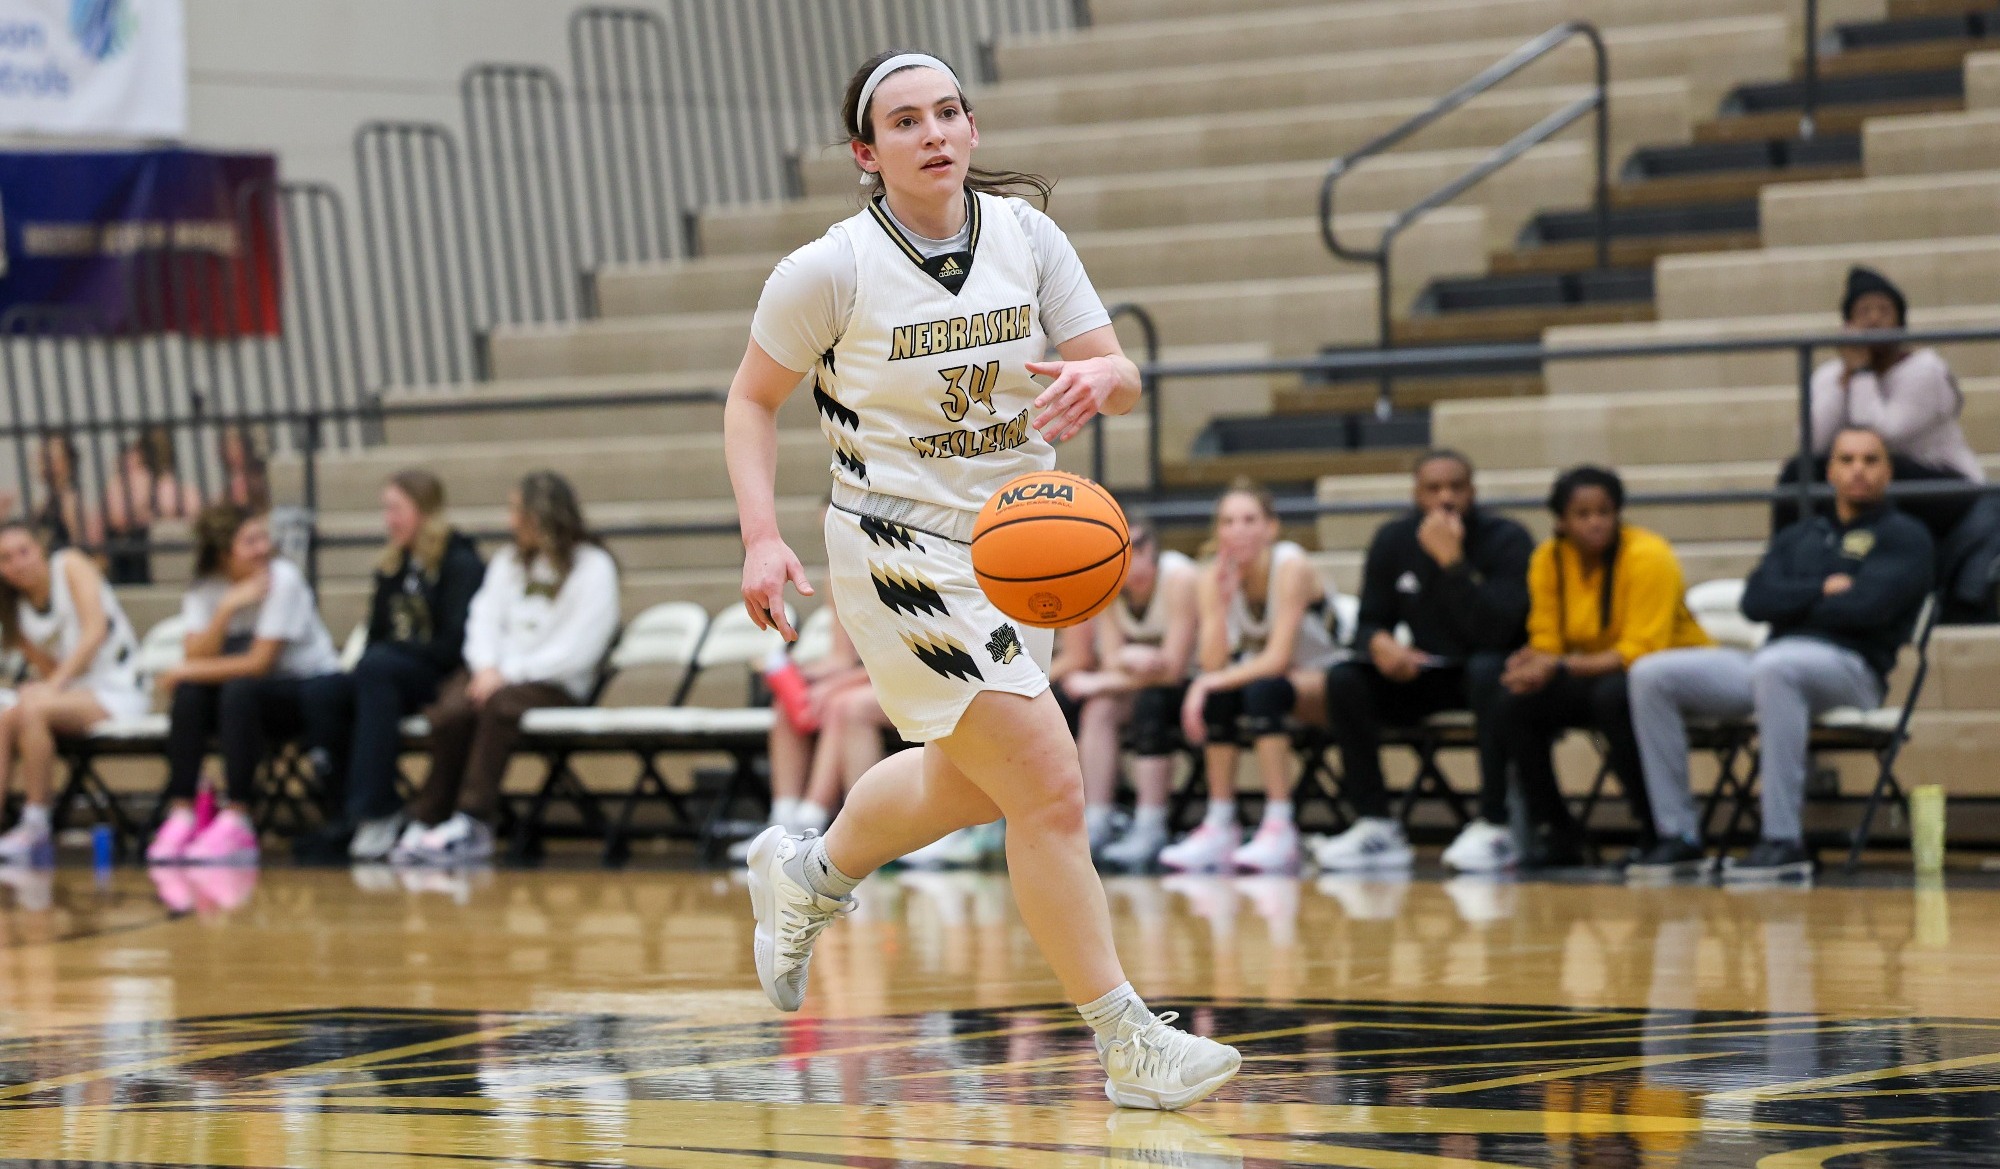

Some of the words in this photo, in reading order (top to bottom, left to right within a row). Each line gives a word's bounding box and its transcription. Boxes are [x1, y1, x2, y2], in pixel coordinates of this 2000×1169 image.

[938, 268, 964, 278] adidas
[888, 304, 1031, 361] NEBRASKA
[938, 360, 1000, 423] 34
[996, 482, 1075, 511] NCAA
